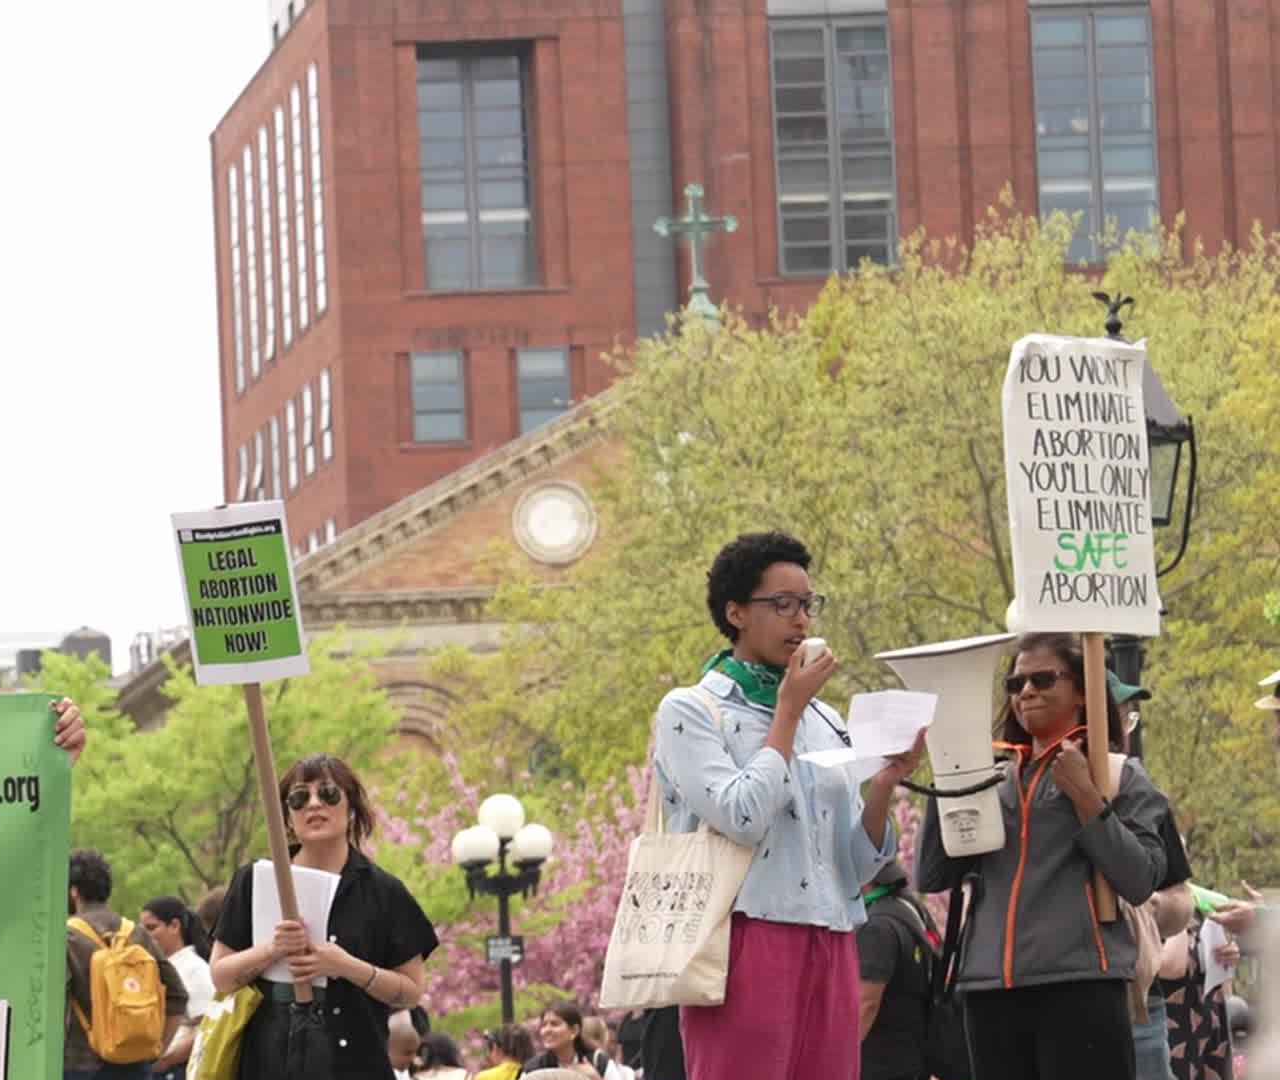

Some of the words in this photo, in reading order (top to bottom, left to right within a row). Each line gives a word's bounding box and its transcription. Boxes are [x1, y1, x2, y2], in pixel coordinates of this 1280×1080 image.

[1019, 353, 1061, 384] YOU
[1027, 391, 1137, 424] ELIMINATE
[1033, 428, 1140, 461] ABORTION
[1100, 463, 1148, 501] ONLY
[1037, 498, 1146, 534] ELIMINATE
[207, 547, 257, 571] LEGAL
[1053, 532, 1129, 571] SAFE
[198, 572, 278, 600] ABORTION
[1039, 571, 1148, 607] ABORTION
[192, 599, 293, 628] NATIONWIDE
[224, 631, 269, 654] NOW!
